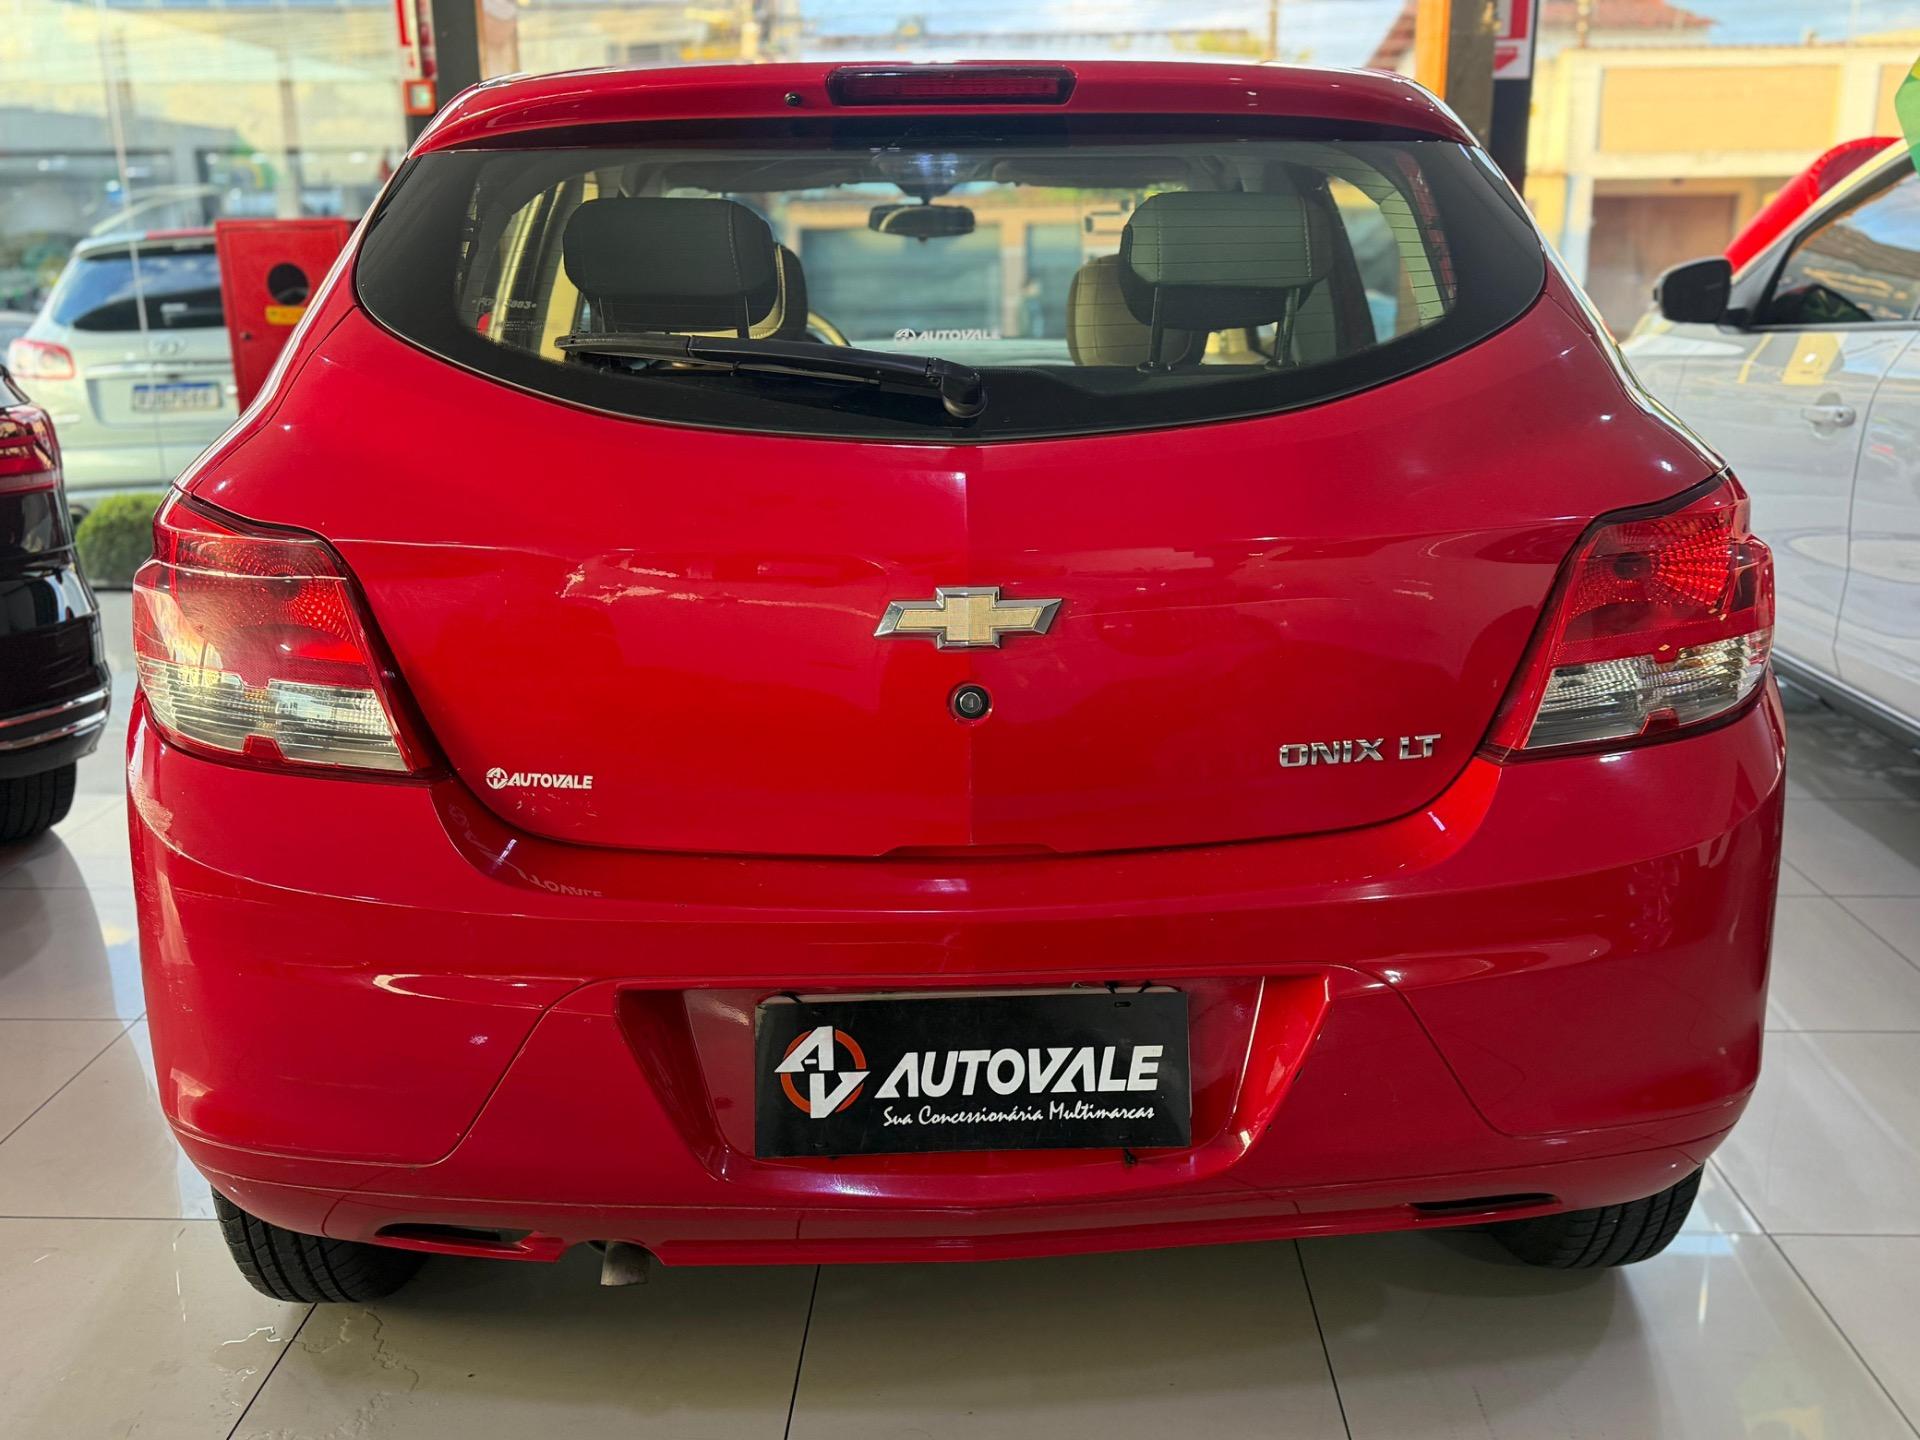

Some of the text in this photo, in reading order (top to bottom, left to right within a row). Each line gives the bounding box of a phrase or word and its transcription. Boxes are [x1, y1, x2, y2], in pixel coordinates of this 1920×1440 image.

[1280, 733, 1441, 767] ONIX LT
[507, 772, 593, 789] AUTOVALE
[874, 1045, 1164, 1099] AUTOVALE
[883, 1100, 1155, 1127] Sua Concessionária Multimarcas
